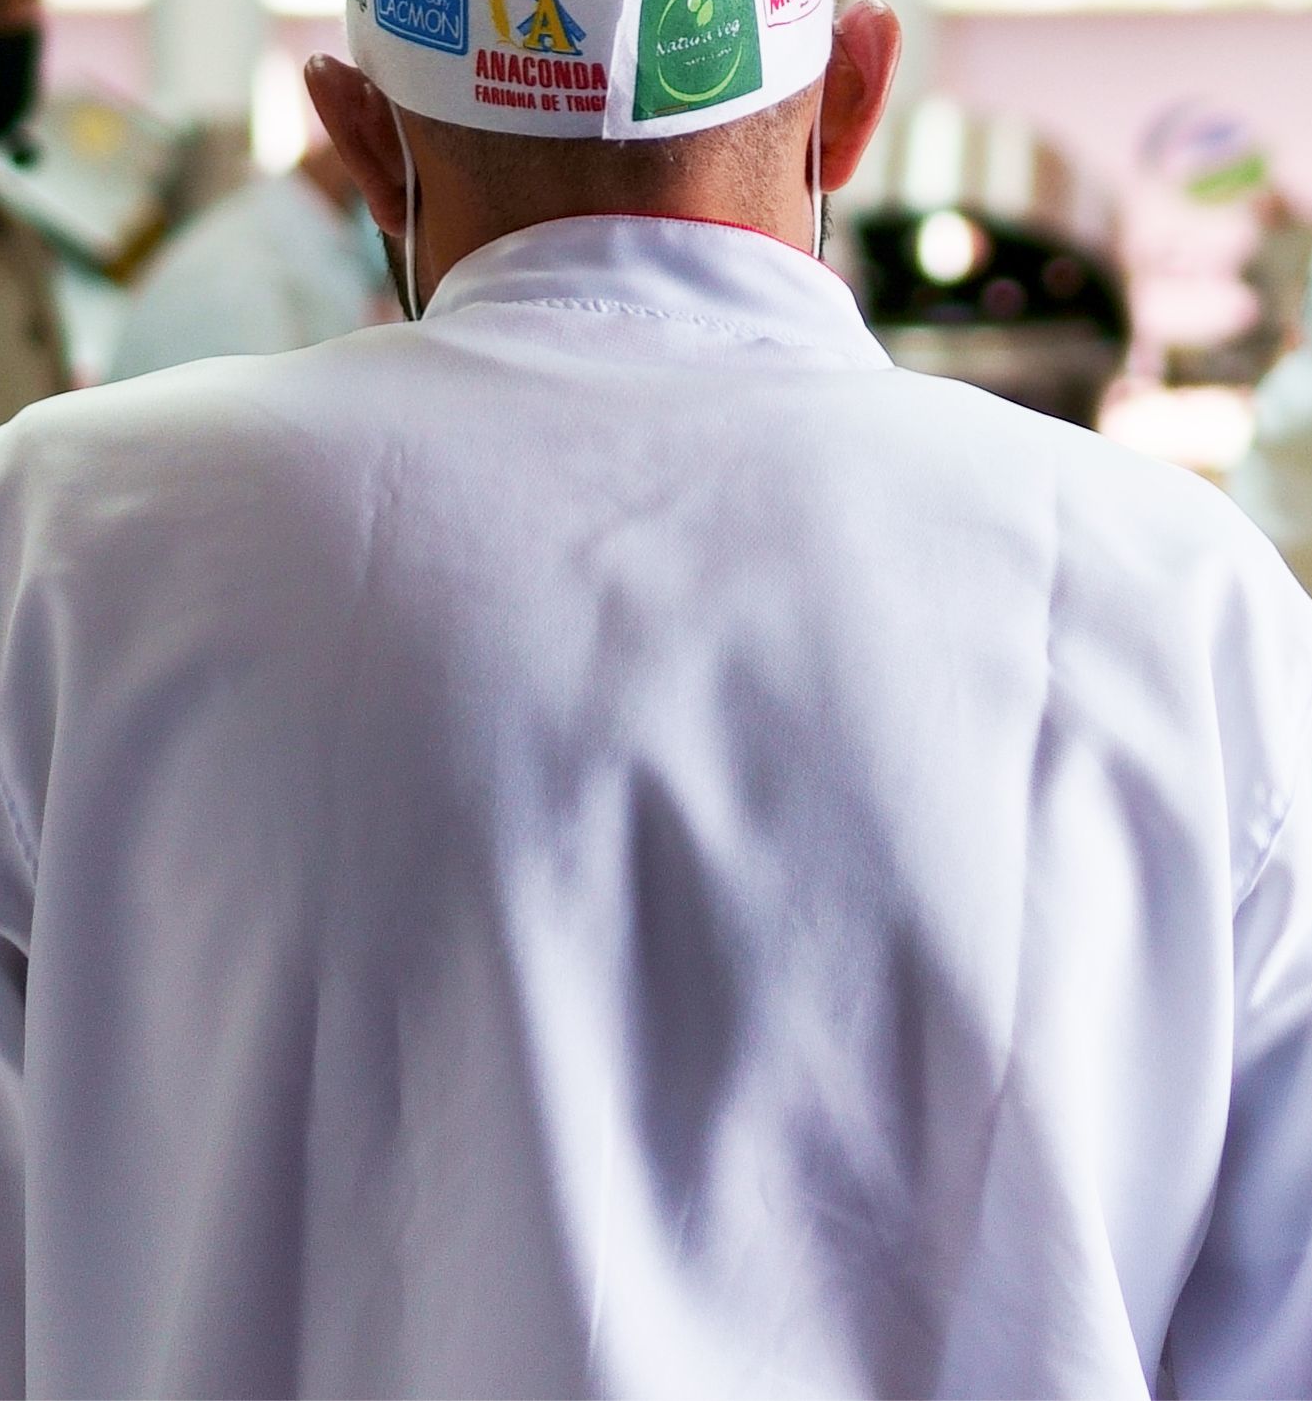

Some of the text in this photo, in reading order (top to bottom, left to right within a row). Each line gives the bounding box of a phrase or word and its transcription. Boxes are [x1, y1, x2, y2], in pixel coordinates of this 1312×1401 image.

[475, 49, 608, 91] ANACONDA
[475, 84, 537, 110] FARINHA
[541, 95, 560, 112] DE
